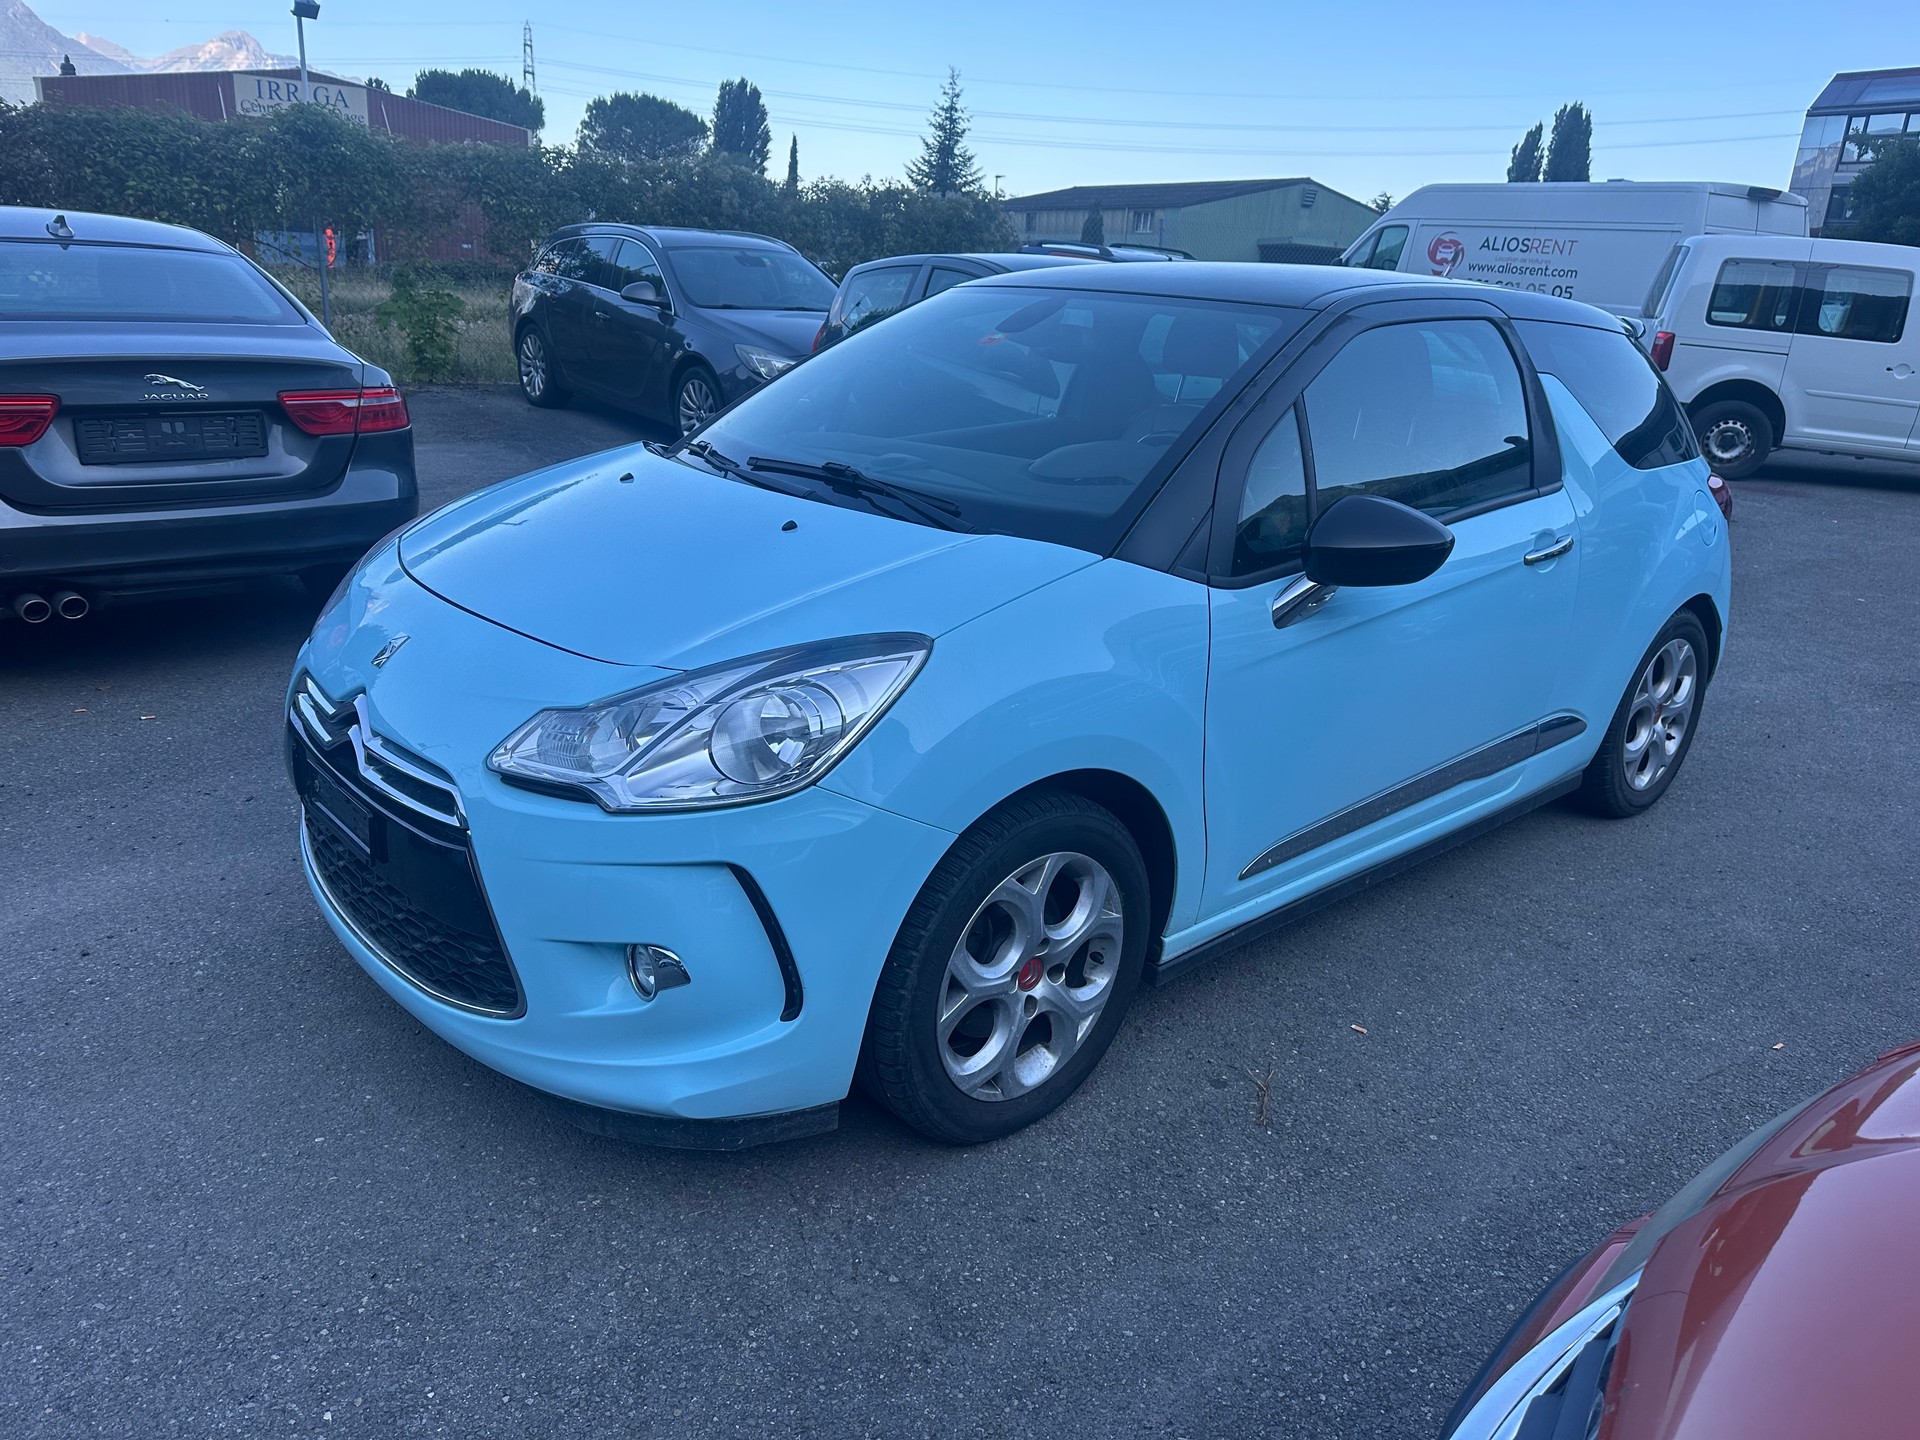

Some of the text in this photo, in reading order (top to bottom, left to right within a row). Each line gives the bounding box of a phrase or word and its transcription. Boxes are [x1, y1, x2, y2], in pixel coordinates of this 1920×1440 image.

[255, 79, 351, 109] IRRGA
[1479, 235, 1579, 256] ALIOSRENT
[1468, 262, 1578, 279] www.aliosrent.com
[1551, 284, 1574, 300] 05
[138, 393, 209, 402] JAGUAR
